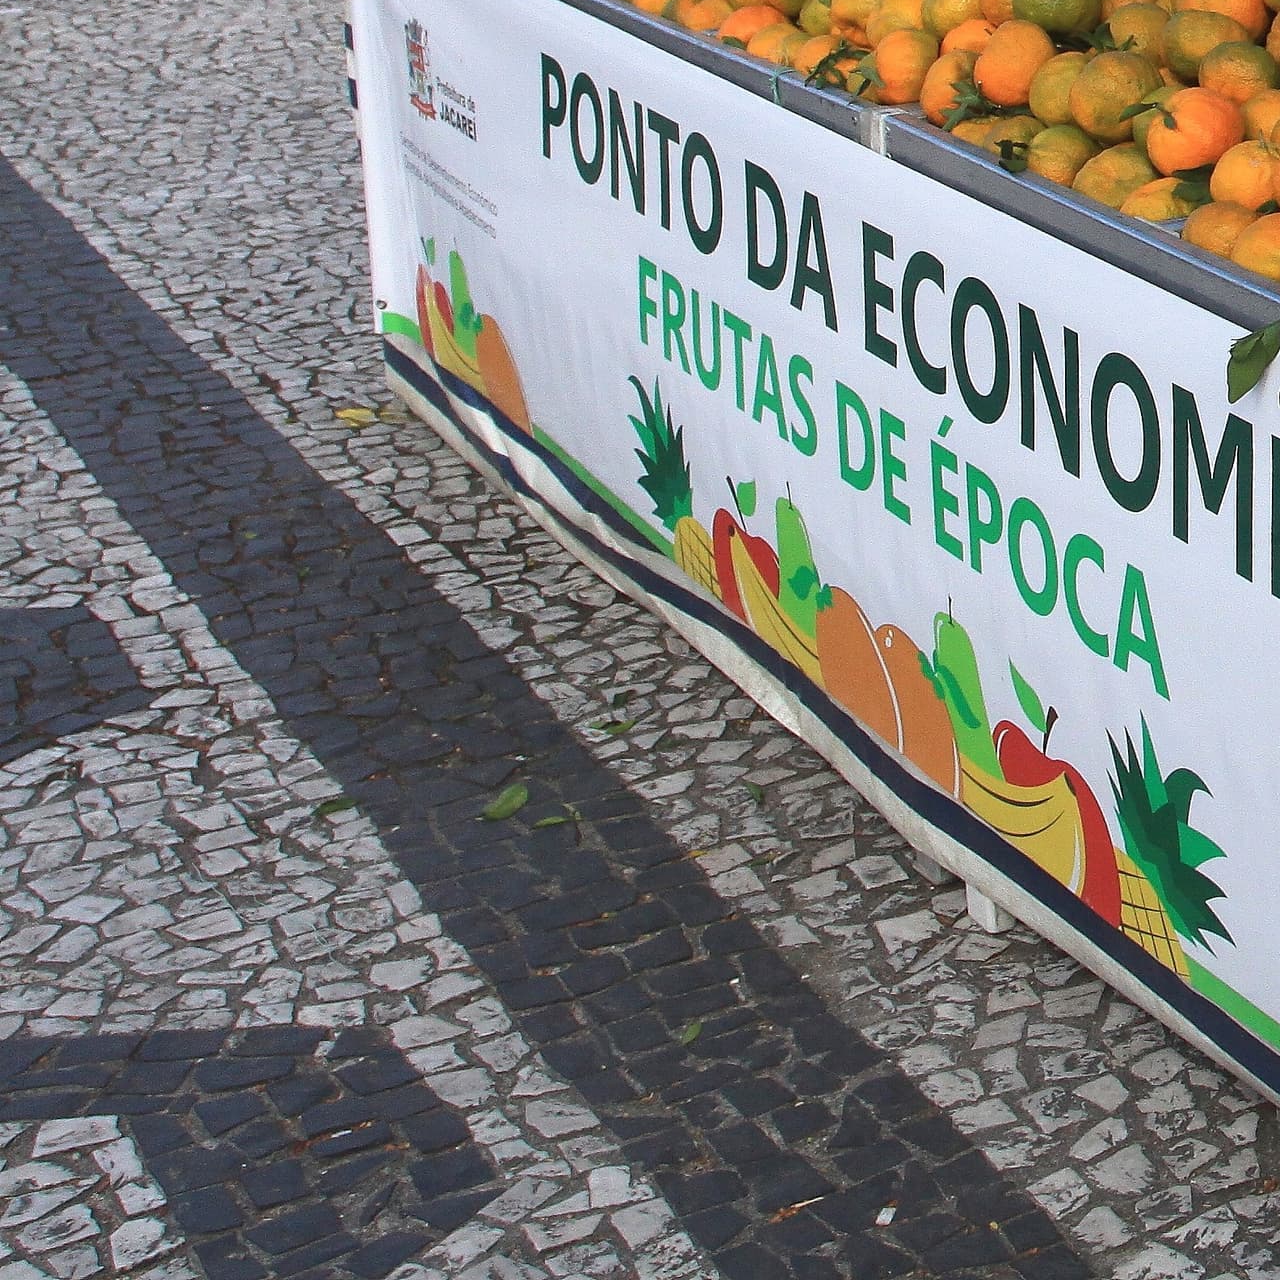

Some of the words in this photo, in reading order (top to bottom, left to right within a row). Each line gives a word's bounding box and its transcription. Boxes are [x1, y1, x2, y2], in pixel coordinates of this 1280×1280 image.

[437, 77, 466, 108] Prefeitura
[467, 96, 475, 113] de
[440, 101, 477, 141] JACAREÍ
[540, 52, 723, 255] PONTO
[745, 159, 838, 333] DA
[638, 255, 818, 456] FRUTAS
[835, 380, 911, 526] DE
[930, 415, 1170, 702] ÉPOCA
